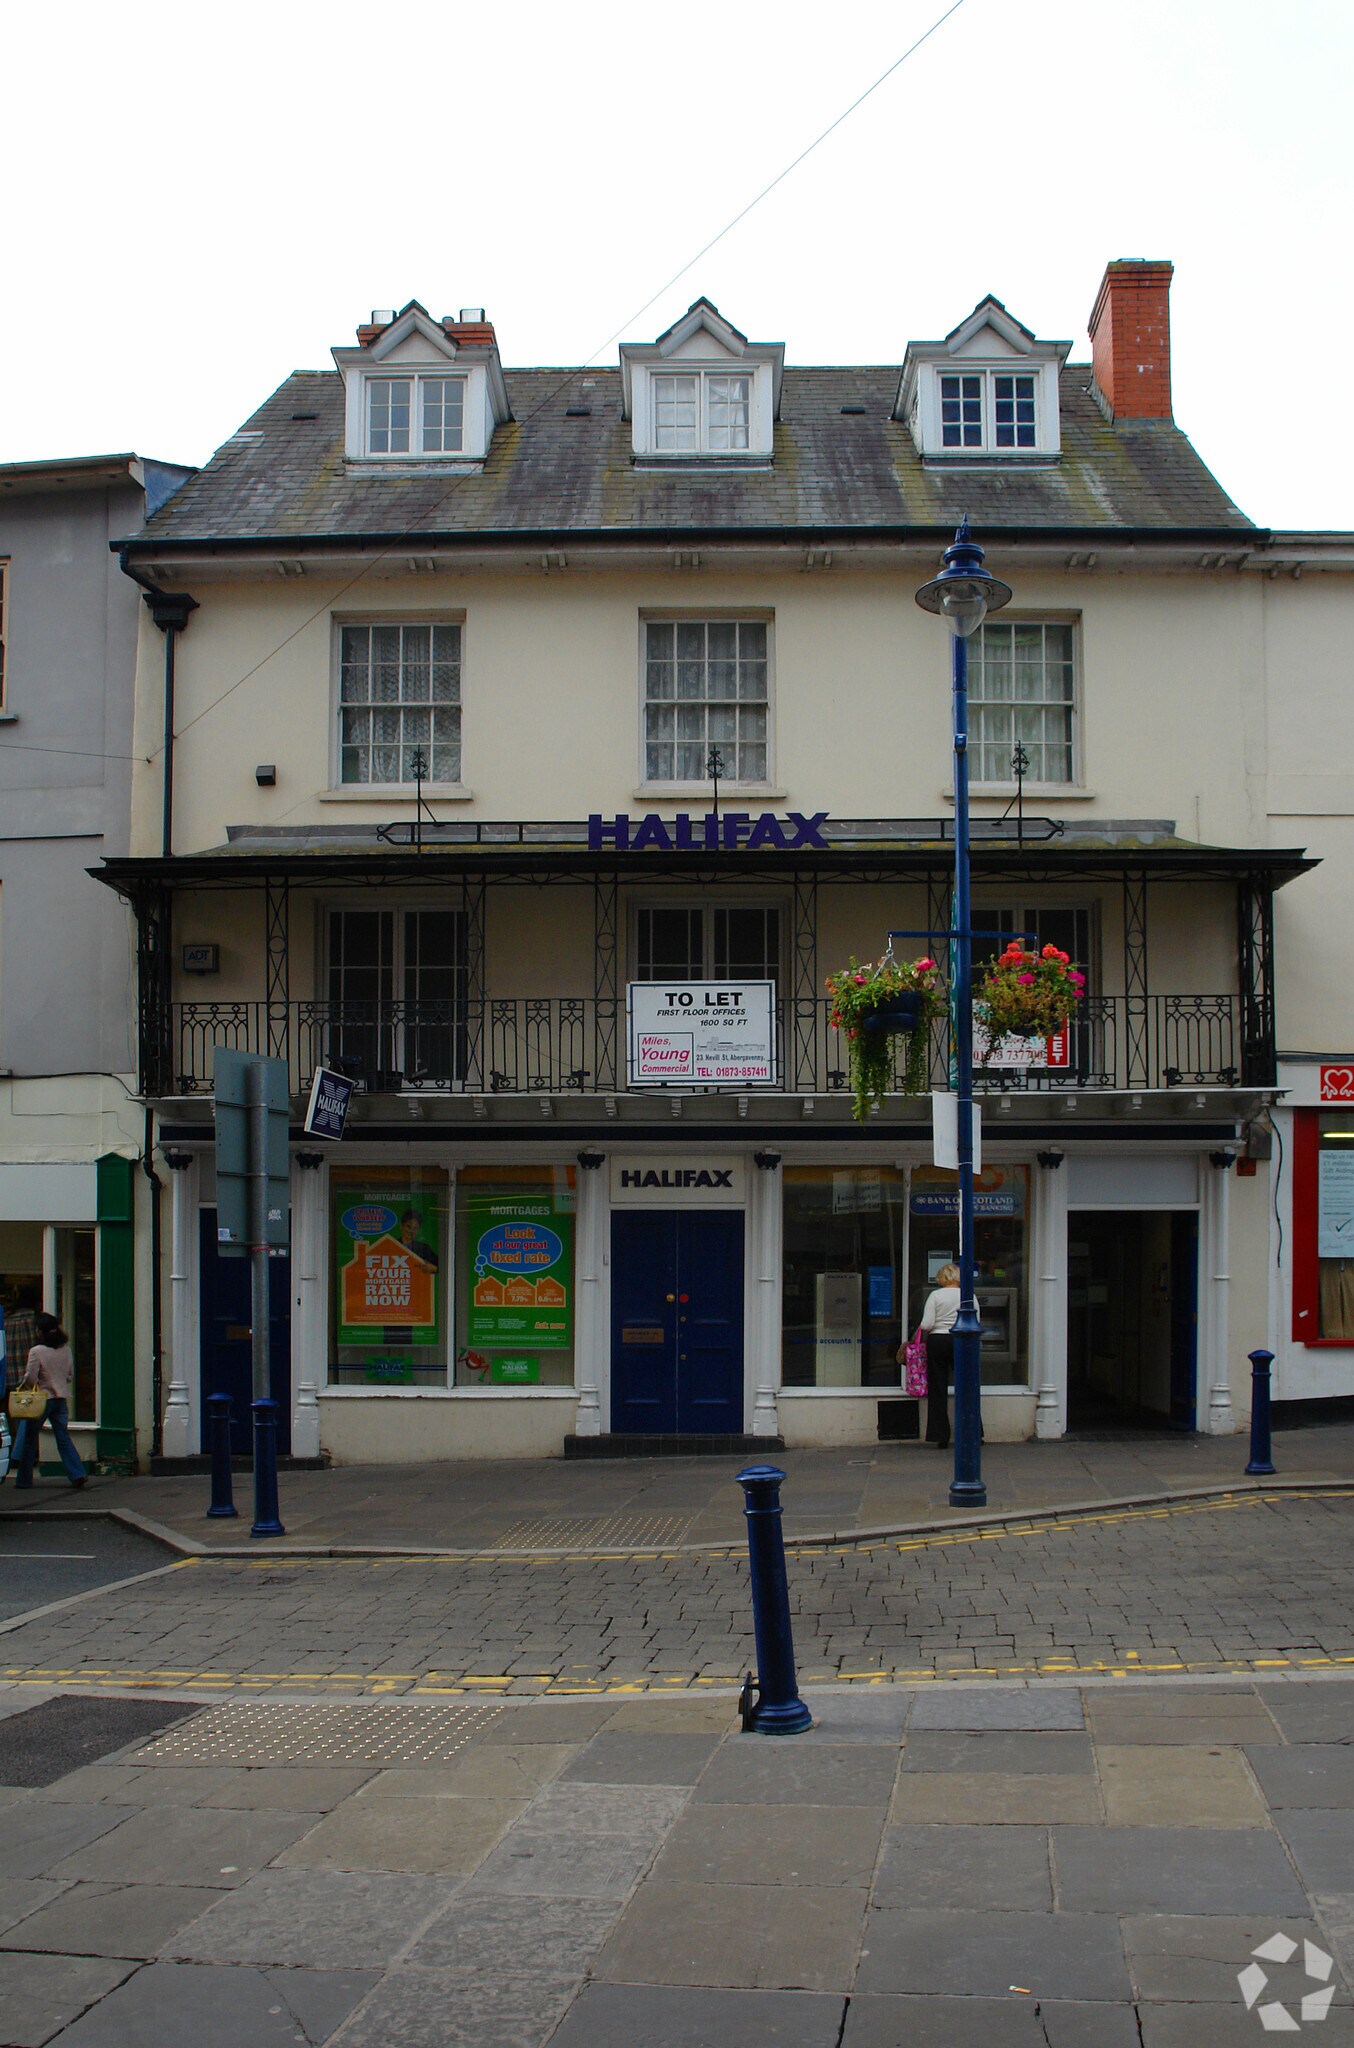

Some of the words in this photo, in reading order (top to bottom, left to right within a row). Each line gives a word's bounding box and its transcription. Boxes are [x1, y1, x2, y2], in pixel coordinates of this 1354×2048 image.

[588, 813, 829, 850] HALIFAX
[188, 951, 209, 960] ADT
[665, 992, 693, 1006] TO
[705, 992, 743, 1006] LET
[712, 1008, 746, 1016] OFFICES
[737, 1018, 748, 1026] FT
[641, 1037, 671, 1046] Miles,
[641, 1048, 690, 1062] Young
[641, 1064, 689, 1073] Commercial
[697, 1067, 713, 1077] TEL:
[716, 1067, 767, 1077] 01873-857411
[317, 1094, 346, 1117] HALIFAX
[621, 1170, 733, 1187] HALIFAX
[364, 1193, 412, 1202] MORTGAGES
[927, 1196, 950, 1204] BANK
[952, 1196, 960, 1204] O
[490, 1205, 550, 1216] MORTGAGES
[505, 1227, 536, 1240] Look
[493, 1241, 504, 1249] at
[523, 1242, 548, 1251] great
[365, 1255, 410, 1269] FIX
[490, 1252, 521, 1264] fixed
[525, 1252, 551, 1264] rate
[366, 1268, 411, 1279] YOUR
[365, 1284, 411, 1296] RATE
[365, 1295, 410, 1306] NOW
